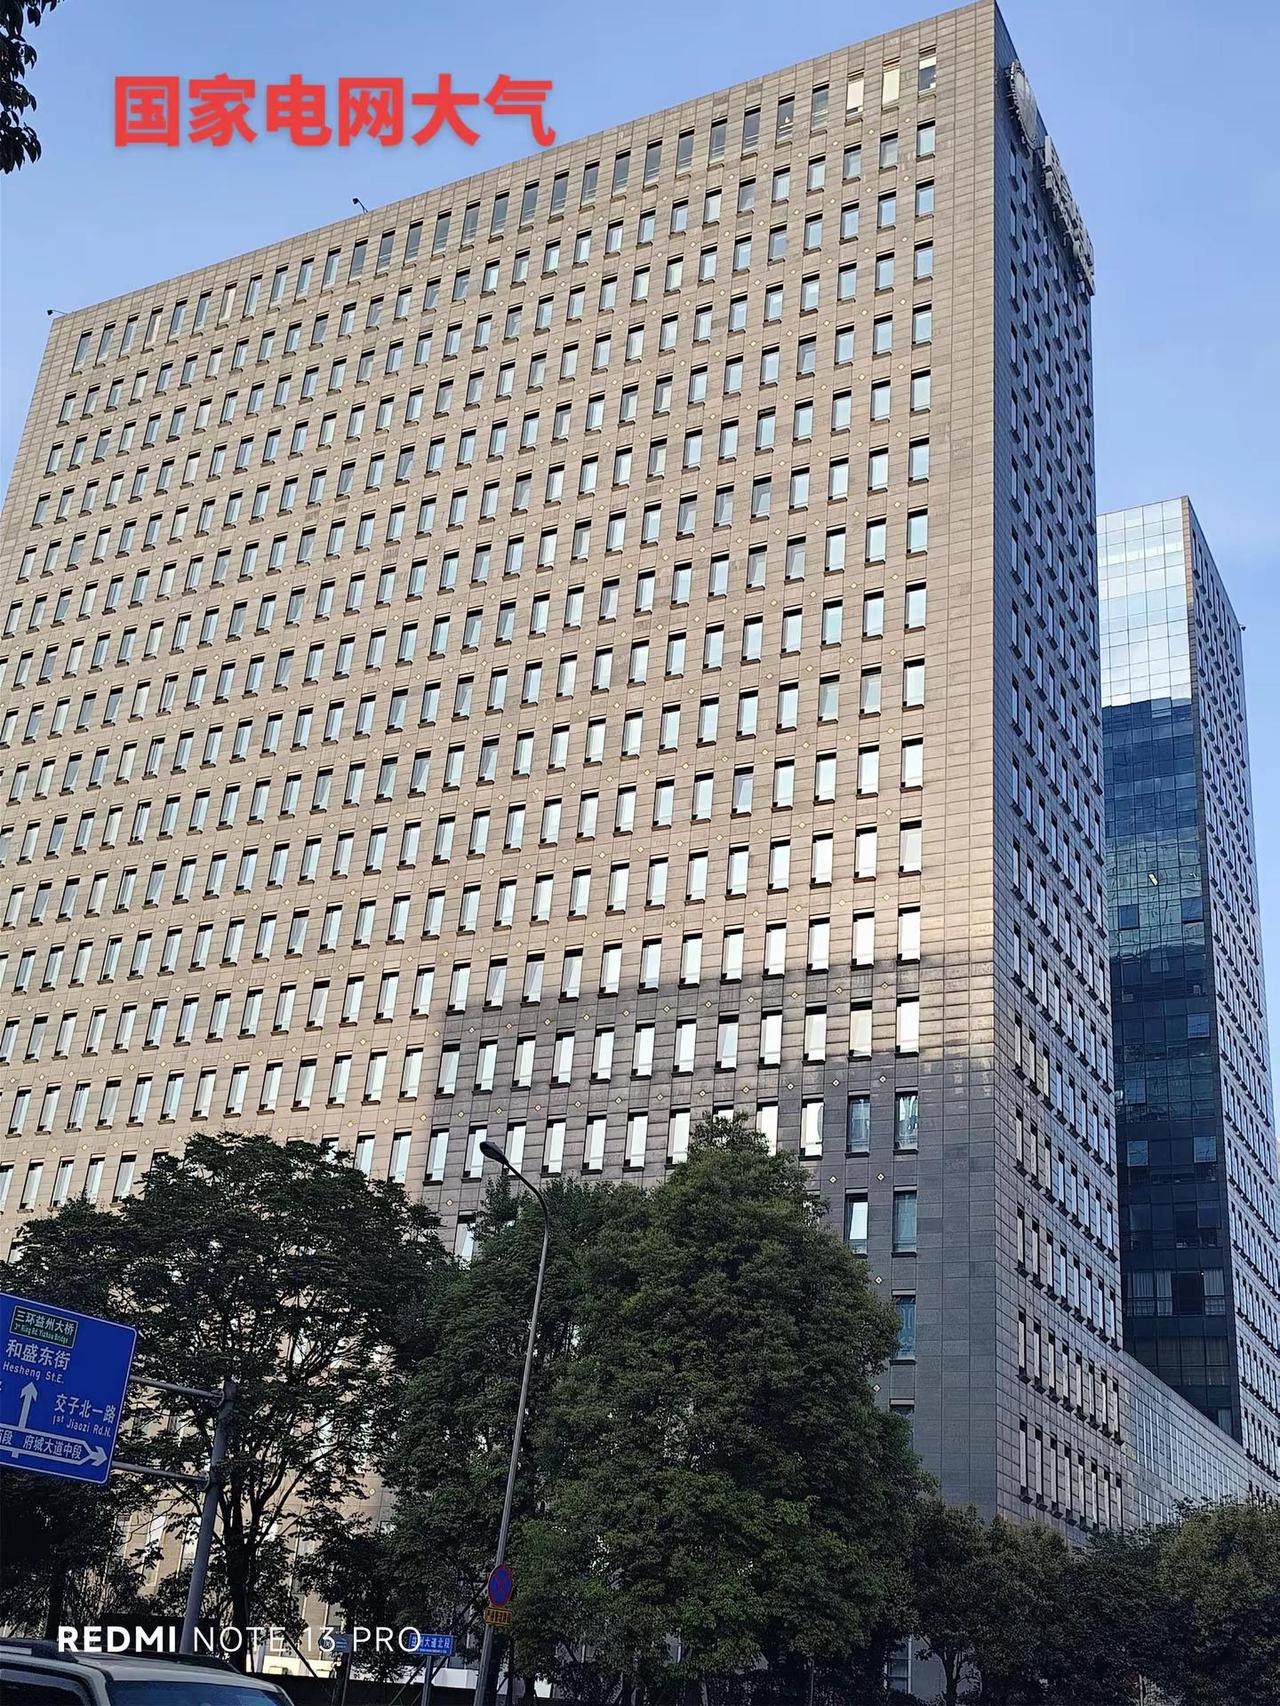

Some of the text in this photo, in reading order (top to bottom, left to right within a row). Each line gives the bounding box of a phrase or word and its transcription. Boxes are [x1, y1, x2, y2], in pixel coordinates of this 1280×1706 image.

[15, 1310, 74, 1335] 三环益州大桥
[6, 1339, 71, 1370] 和盛东街
[2, 1360, 41, 1380] Hesheng
[54, 1393, 116, 1424] 交子北一路
[66, 1418, 90, 1433] Jiaozi
[23, 1434, 83, 1460] 府城大道中段
